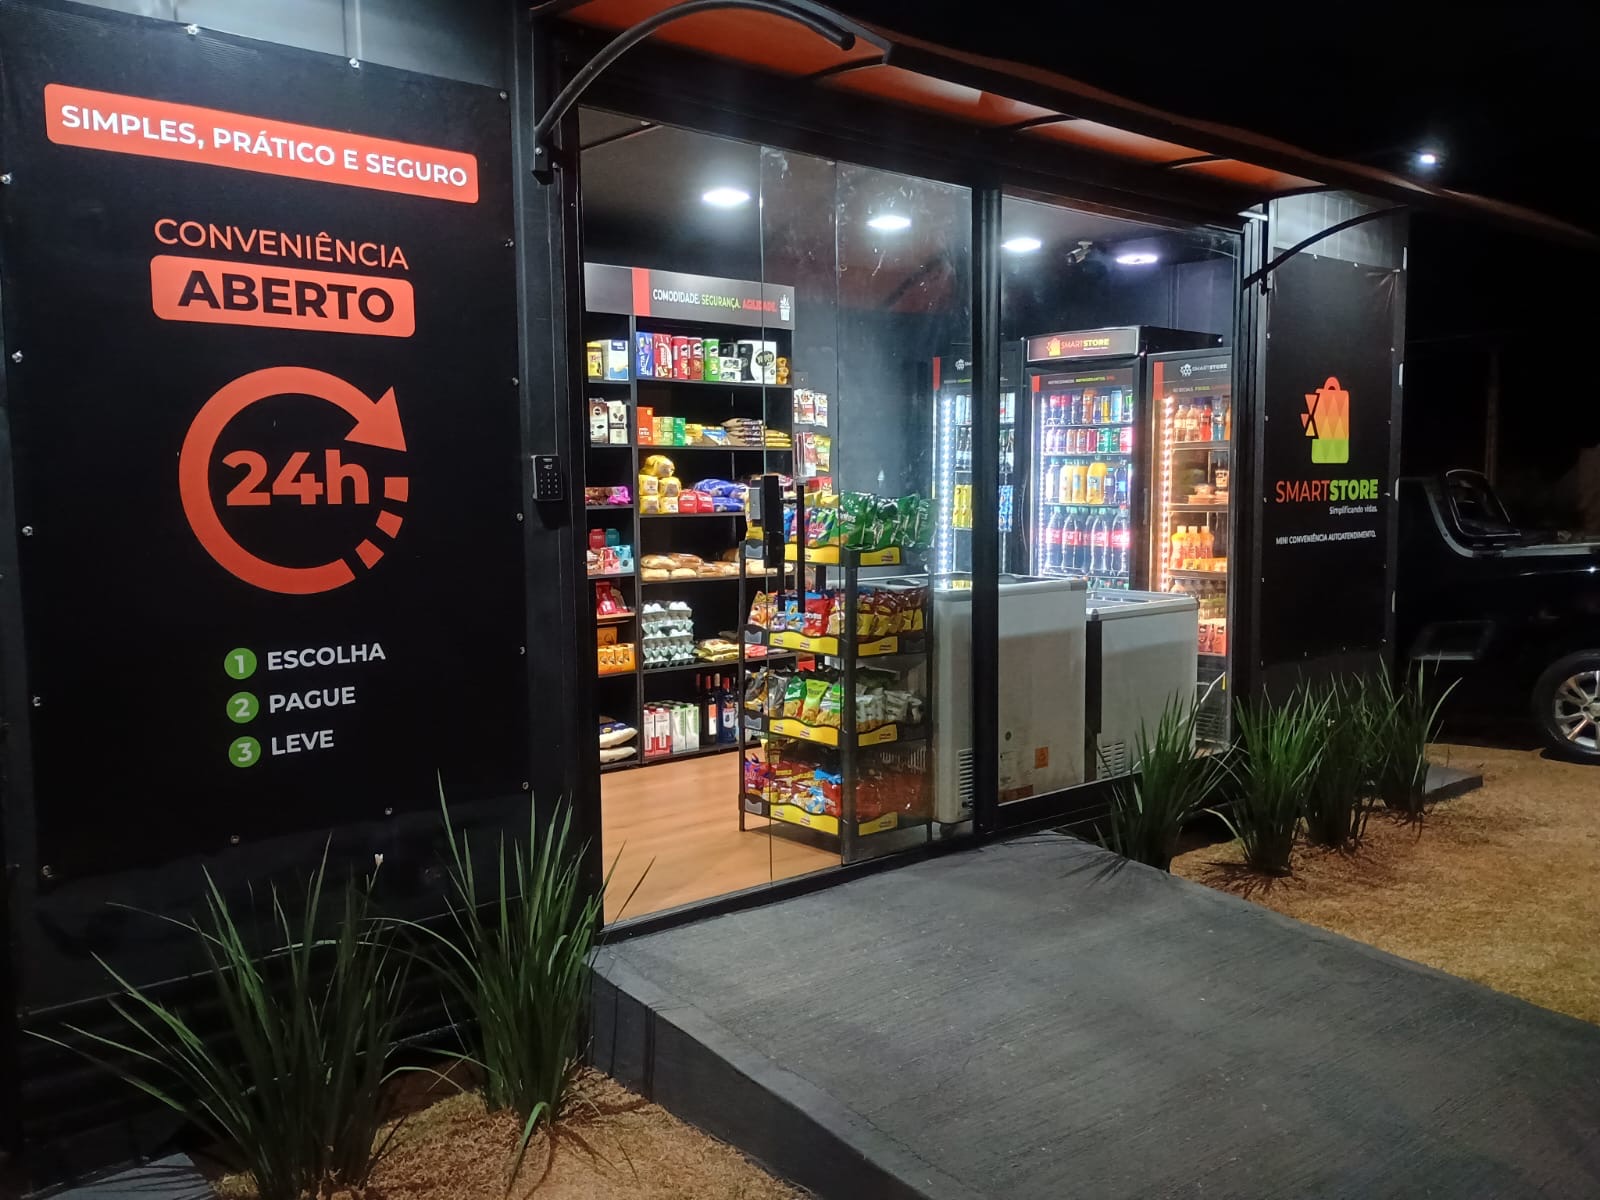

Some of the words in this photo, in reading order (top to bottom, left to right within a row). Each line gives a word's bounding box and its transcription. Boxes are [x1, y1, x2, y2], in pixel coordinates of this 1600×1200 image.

[61, 104, 204, 149] SIMPLES,
[213, 127, 336, 166] PRÁTICO
[344, 150, 359, 170] E
[366, 153, 468, 187] SEGURO
[154, 218, 409, 270] CONVENIÊNCIA
[178, 270, 395, 324] ABERTO
[222, 449, 370, 506] 24h
[1275, 479, 1379, 503] SMARTSTORE
[234, 655, 245, 674] 1
[267, 643, 386, 671] ESCOLHA
[235, 698, 250, 718] 2
[269, 686, 356, 713] PAGUE
[237, 742, 253, 762] 3
[271, 729, 334, 755] LEVE
